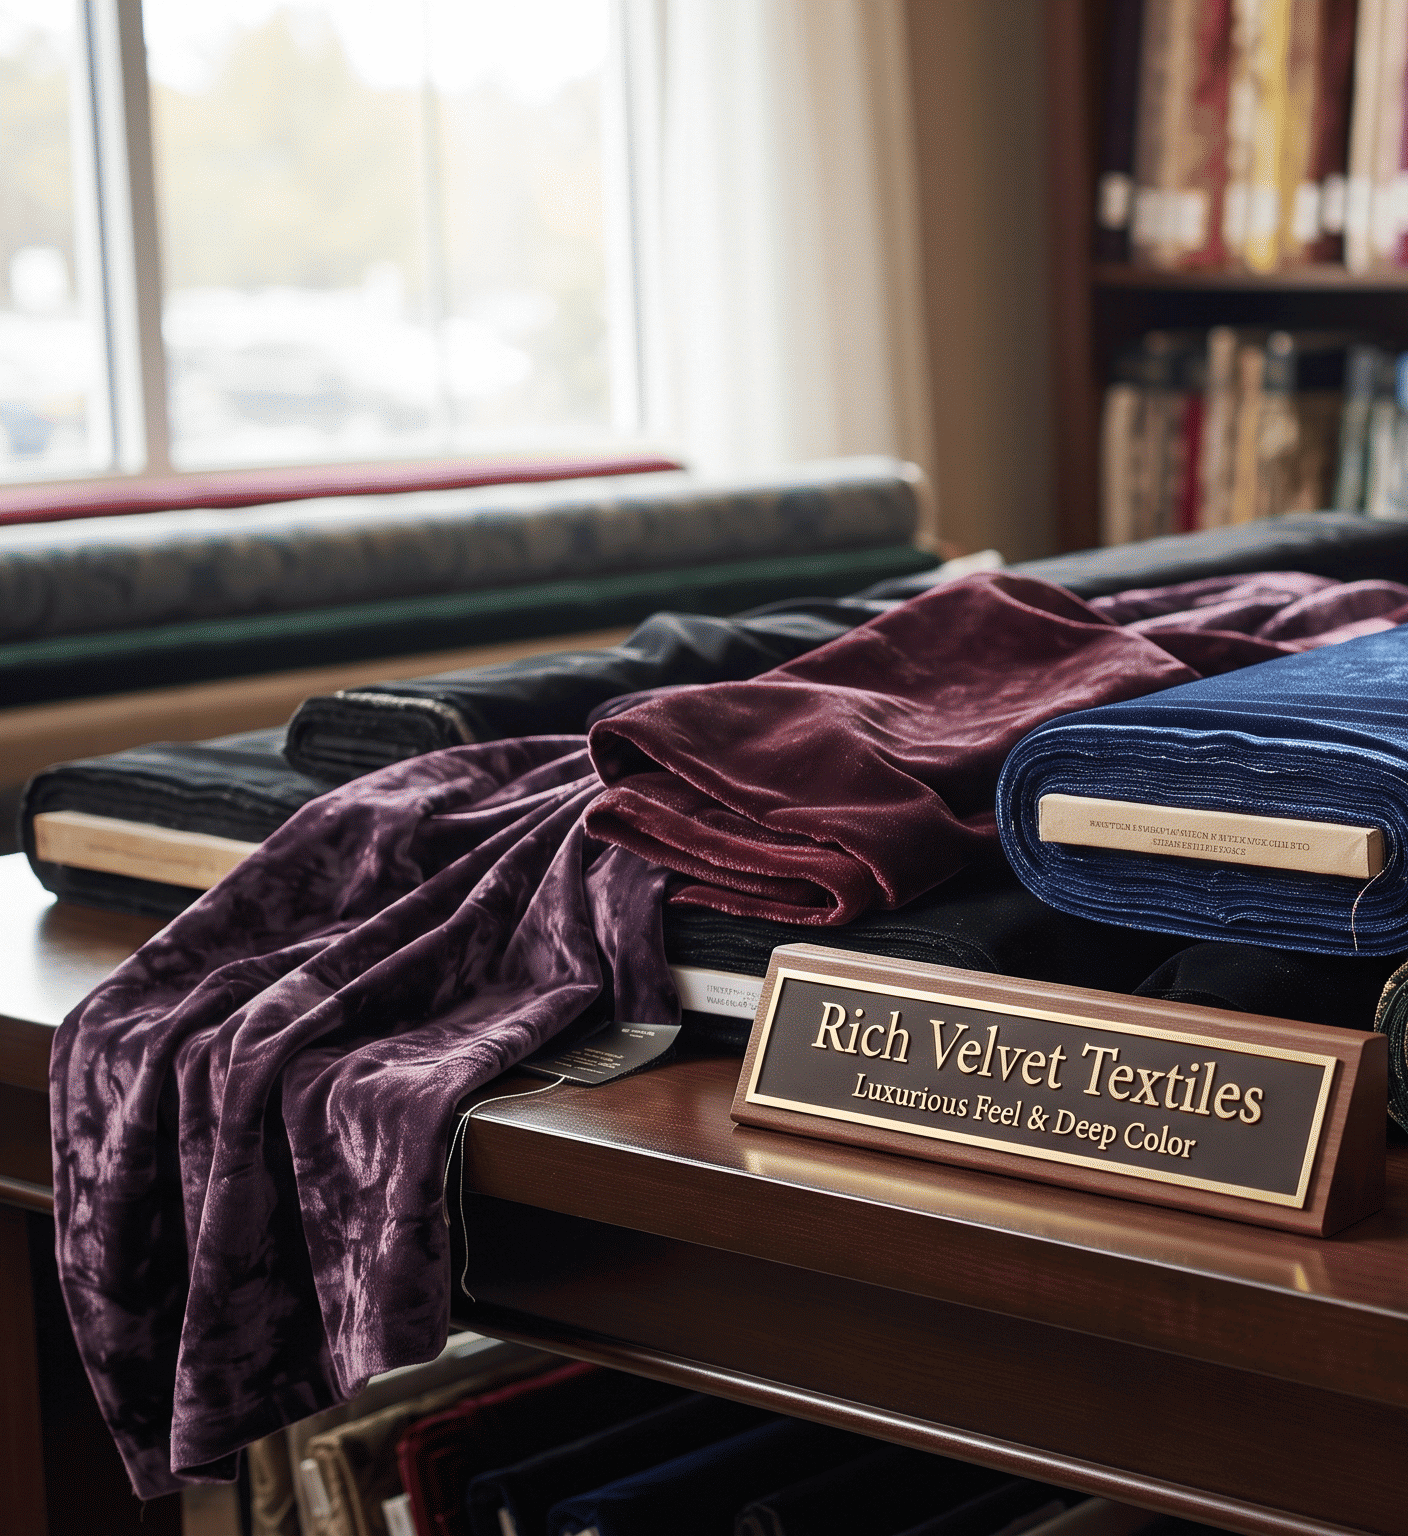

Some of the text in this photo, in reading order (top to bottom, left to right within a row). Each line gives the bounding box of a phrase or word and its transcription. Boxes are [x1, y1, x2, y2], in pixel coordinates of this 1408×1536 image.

[811, 1001, 1265, 1125] Rich Velvet Textiles
[851, 1072, 1198, 1159] Luxurious Feel & Deep Color
